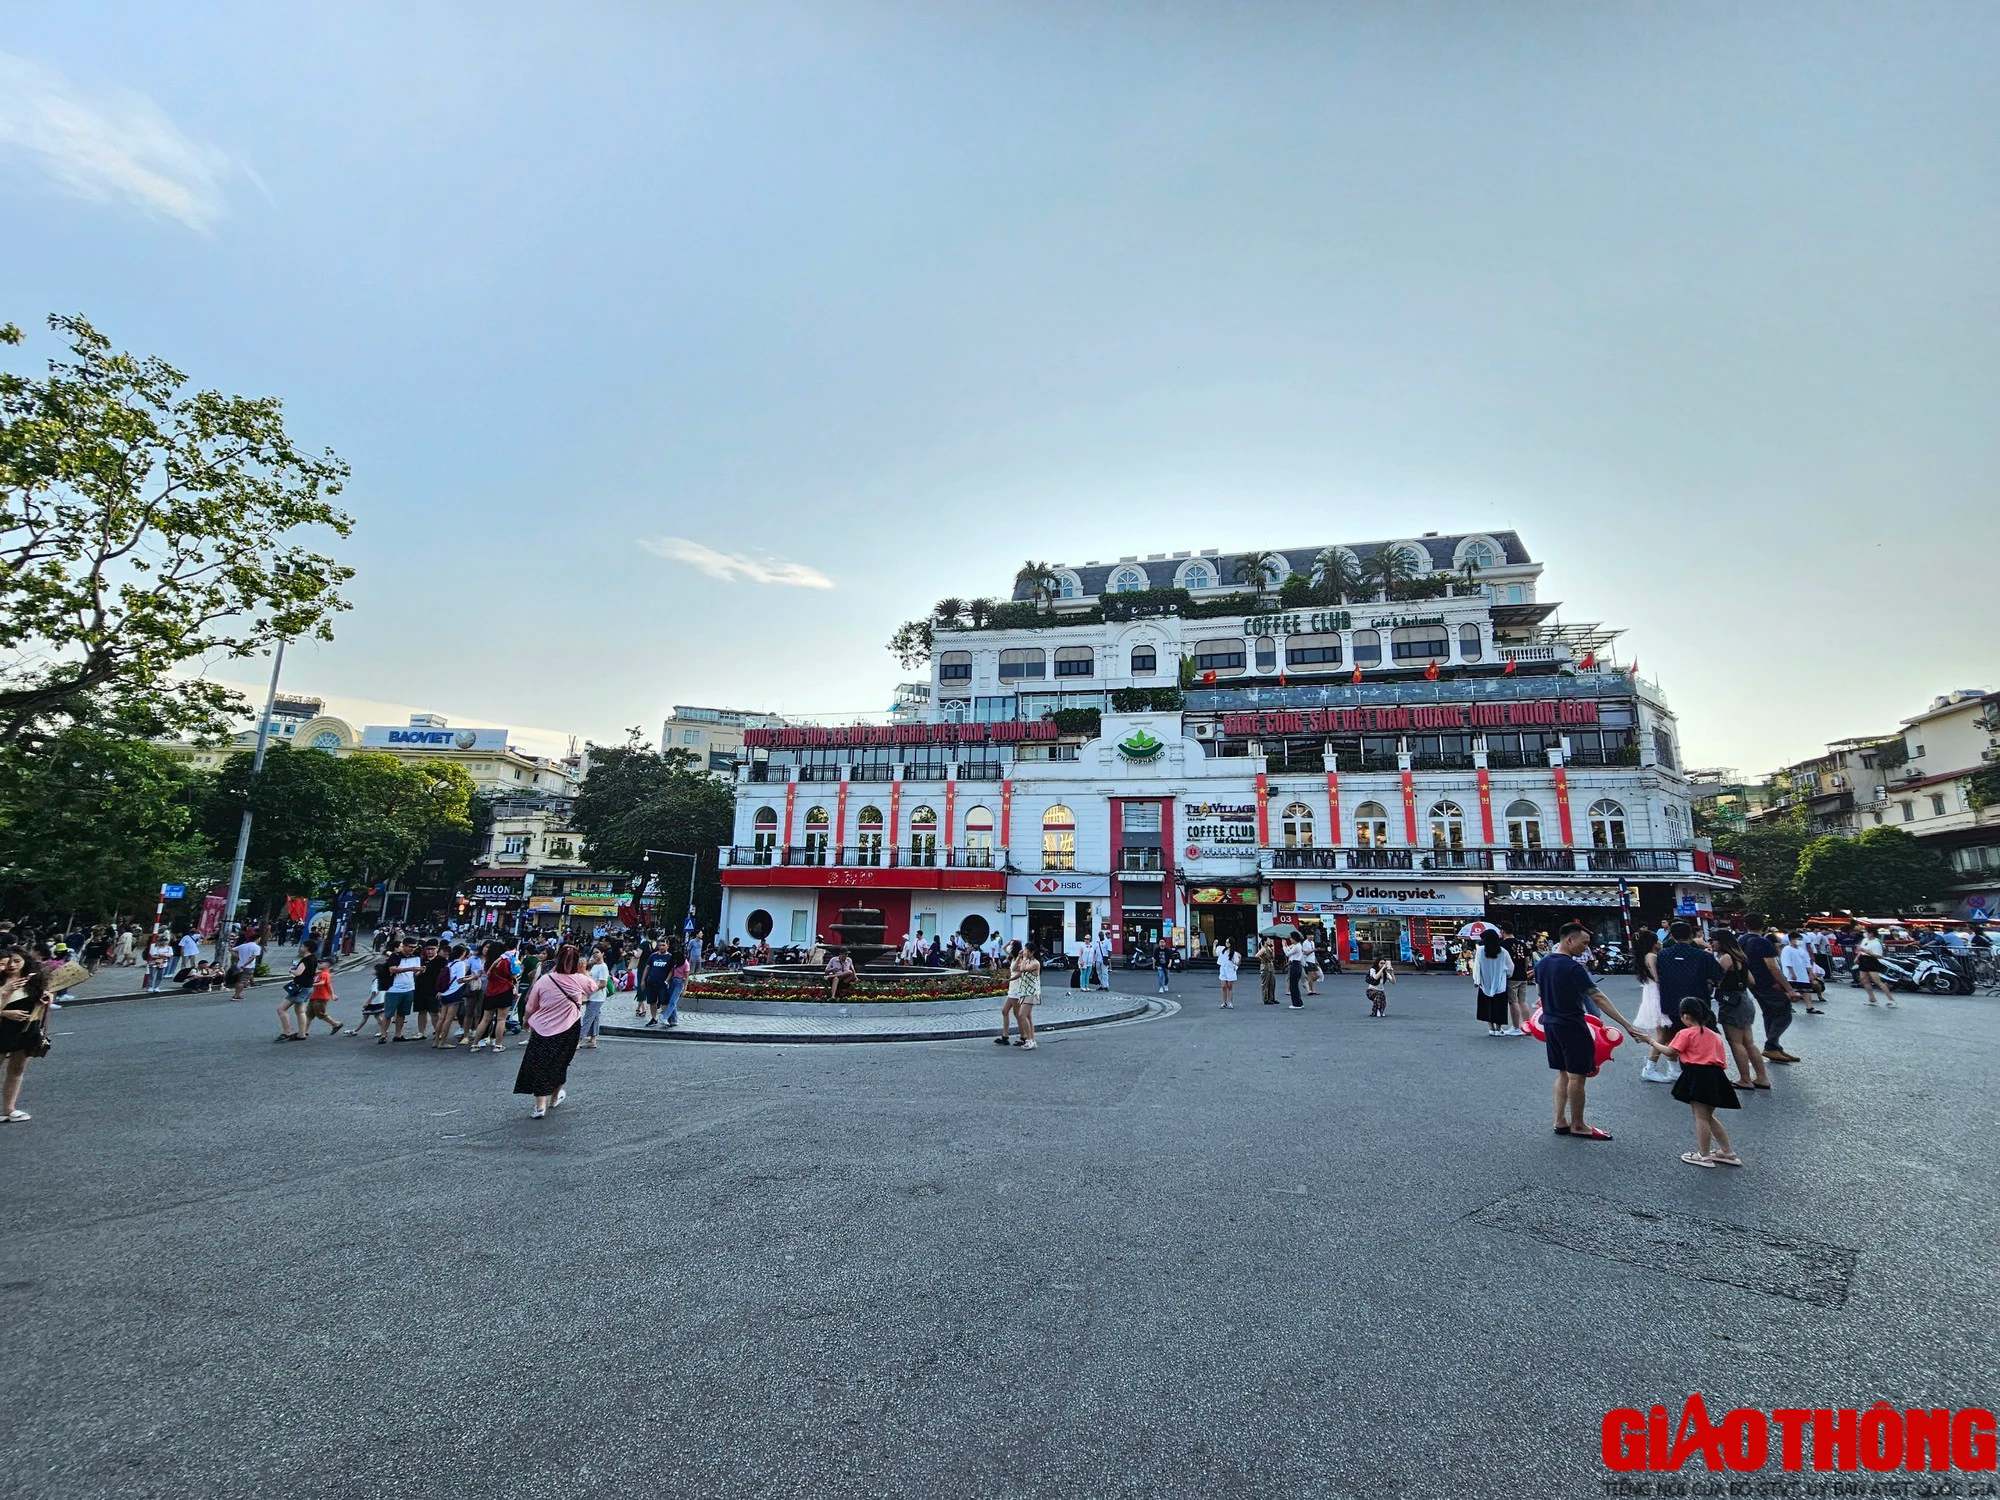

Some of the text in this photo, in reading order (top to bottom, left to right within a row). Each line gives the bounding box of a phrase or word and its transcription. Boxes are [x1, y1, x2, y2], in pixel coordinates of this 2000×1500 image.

[1243, 611, 1350, 636] COFFEE CLUB
[1392, 617, 1399, 627] &
[1401, 613, 1445, 626] Restaurant
[1376, 708, 1410, 730] NAM
[1413, 705, 1464, 730] QUANG
[1469, 704, 1505, 727] VINH
[1508, 699, 1556, 726] MUÔN
[389, 731, 454, 744] BAOVIET
[958, 723, 985, 741] NAM
[1116, 751, 1166, 766] PHYTOPHARCO
[1187, 825, 1255, 837] COFFEE CLUB
[1355, 887, 1446, 901] didongviet.vn
[1510, 889, 1565, 901] VERTU
[1280, 915, 1292, 923] 03
